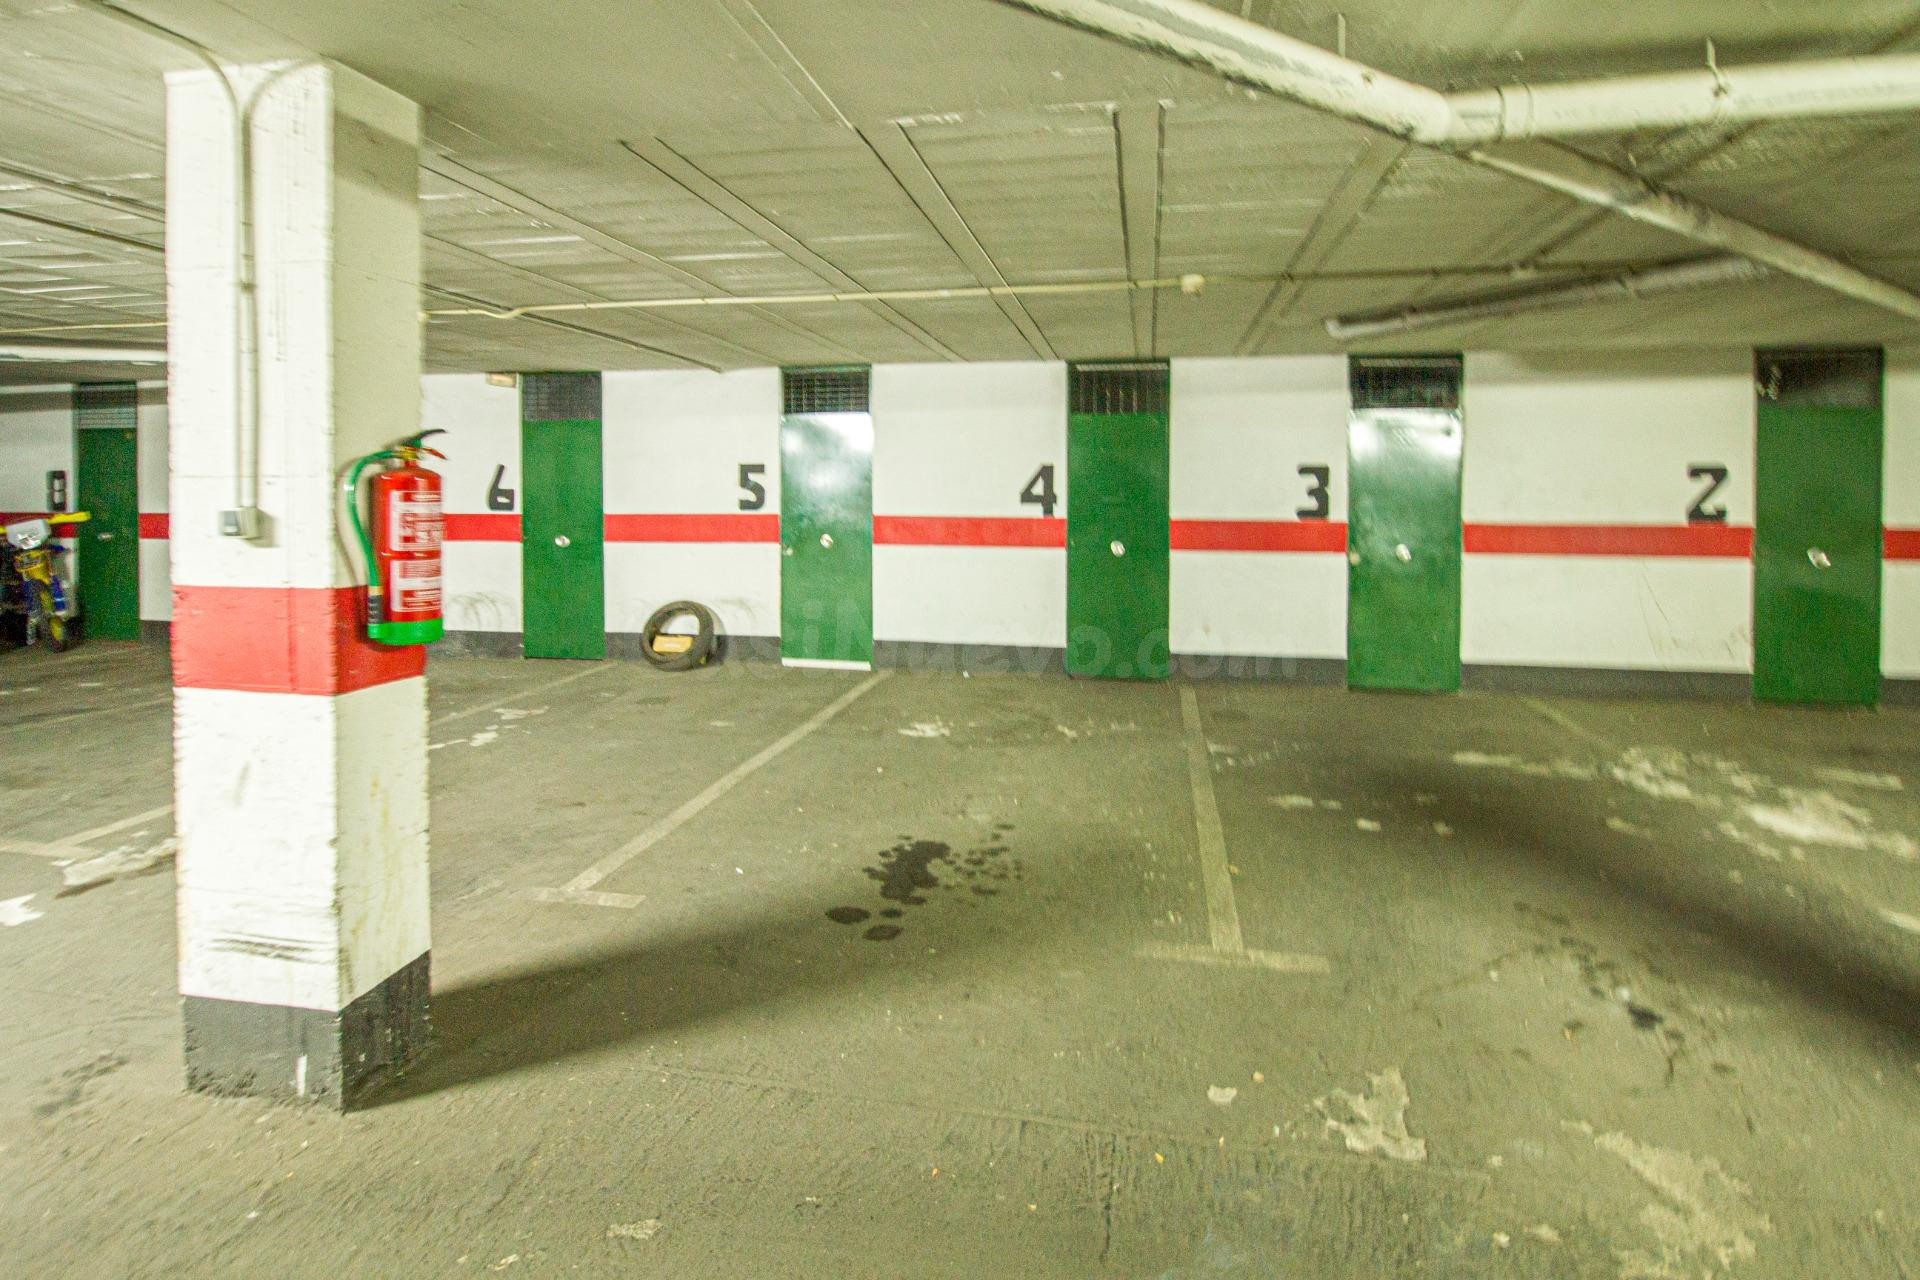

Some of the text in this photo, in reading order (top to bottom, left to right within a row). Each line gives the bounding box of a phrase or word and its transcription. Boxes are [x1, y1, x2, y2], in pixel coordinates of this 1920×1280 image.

[487, 464, 515, 511] 6
[738, 464, 766, 511] 5
[1020, 464, 1057, 518] 4
[1297, 465, 1330, 522] 3
[1688, 466, 1728, 526] 2
